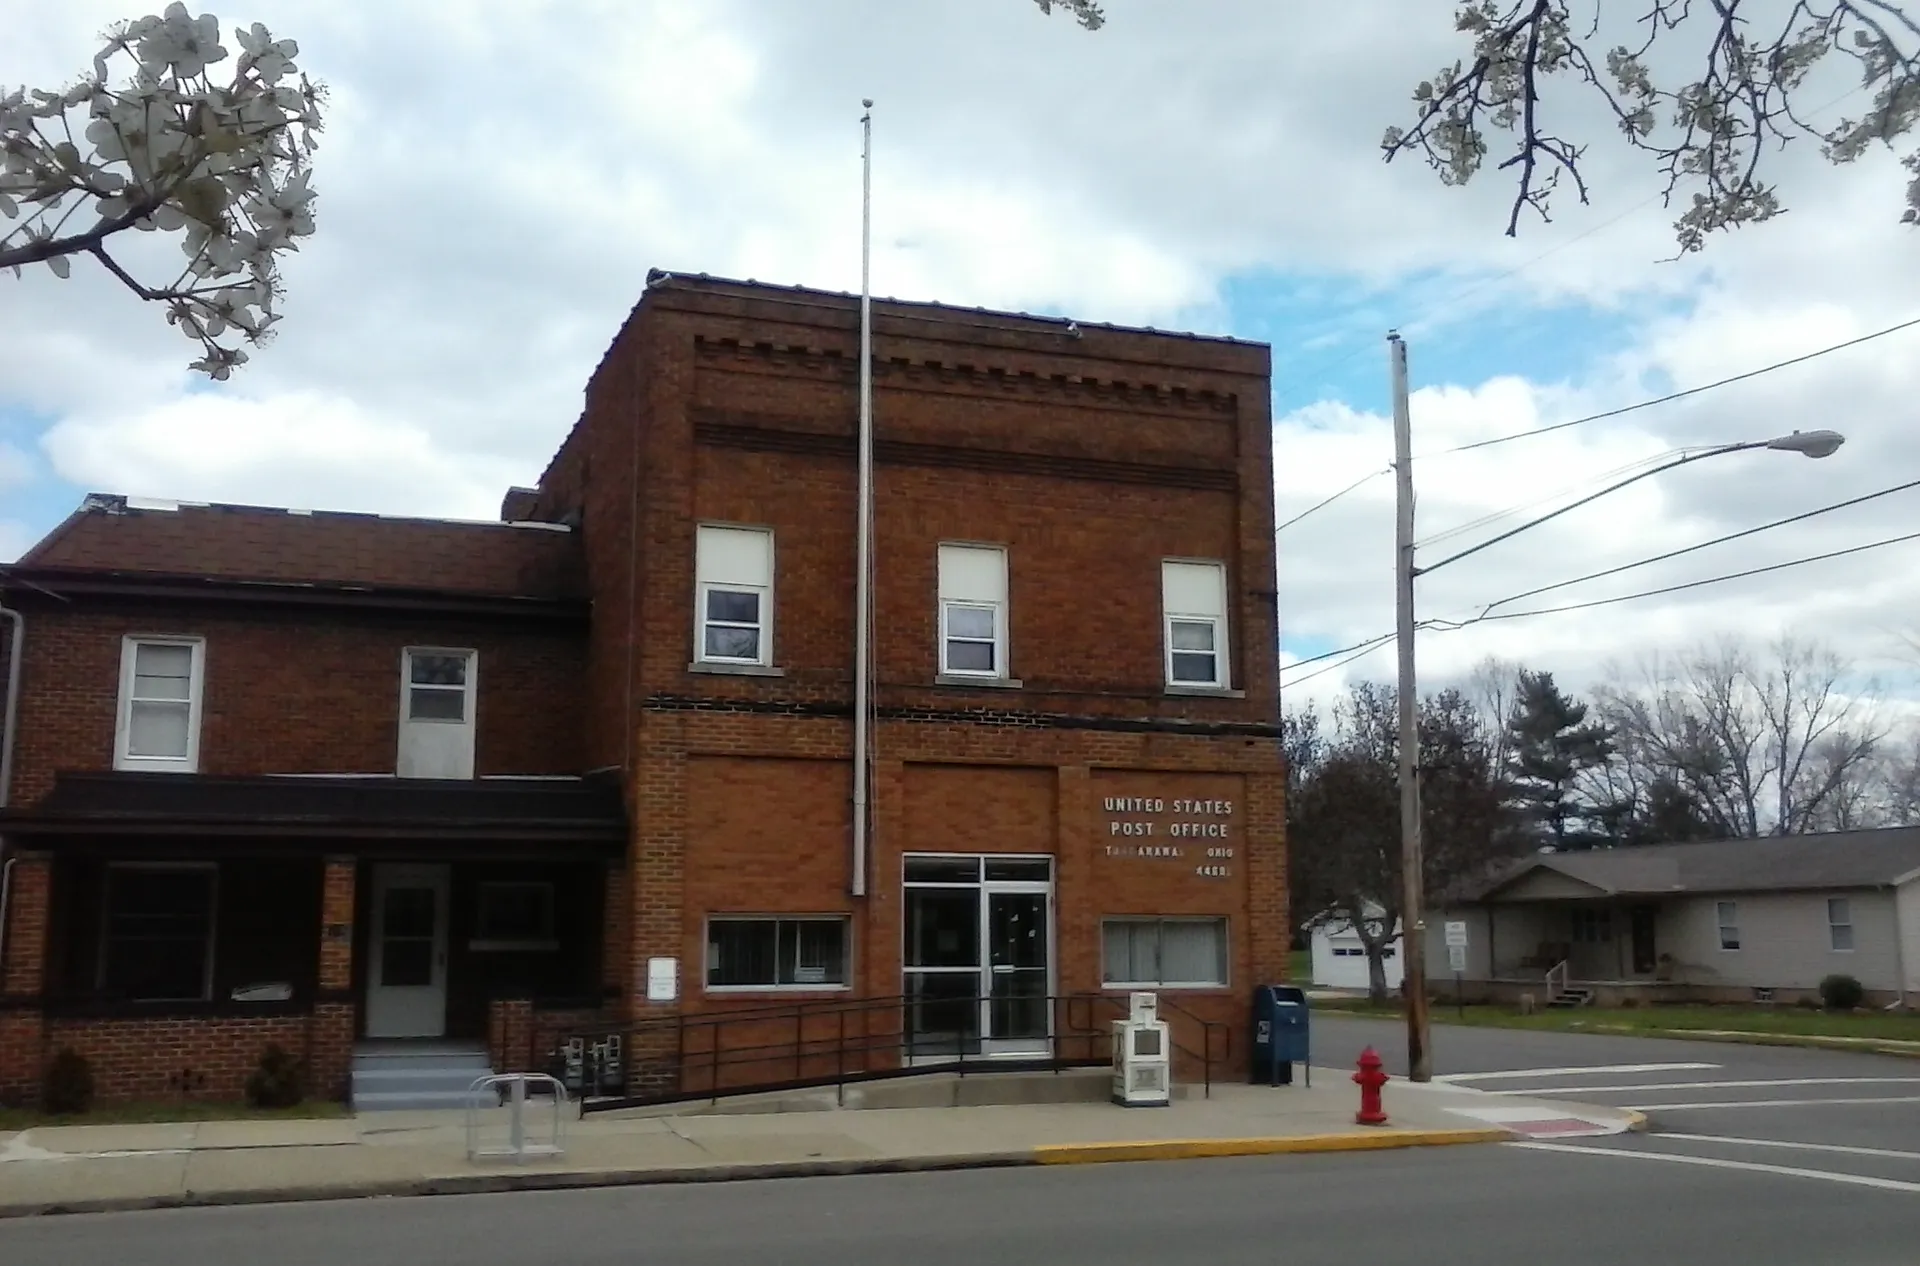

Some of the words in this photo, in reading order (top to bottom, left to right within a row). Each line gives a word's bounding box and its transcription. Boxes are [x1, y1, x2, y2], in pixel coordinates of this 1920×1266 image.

[1104, 797, 1164, 812] UNITED
[1173, 800, 1232, 815] STATES
[1111, 821, 1154, 836] POST
[1170, 823, 1228, 838] OFFICE
[1207, 847, 1233, 858] OHIO
[1195, 866, 1231, 877] 4468
